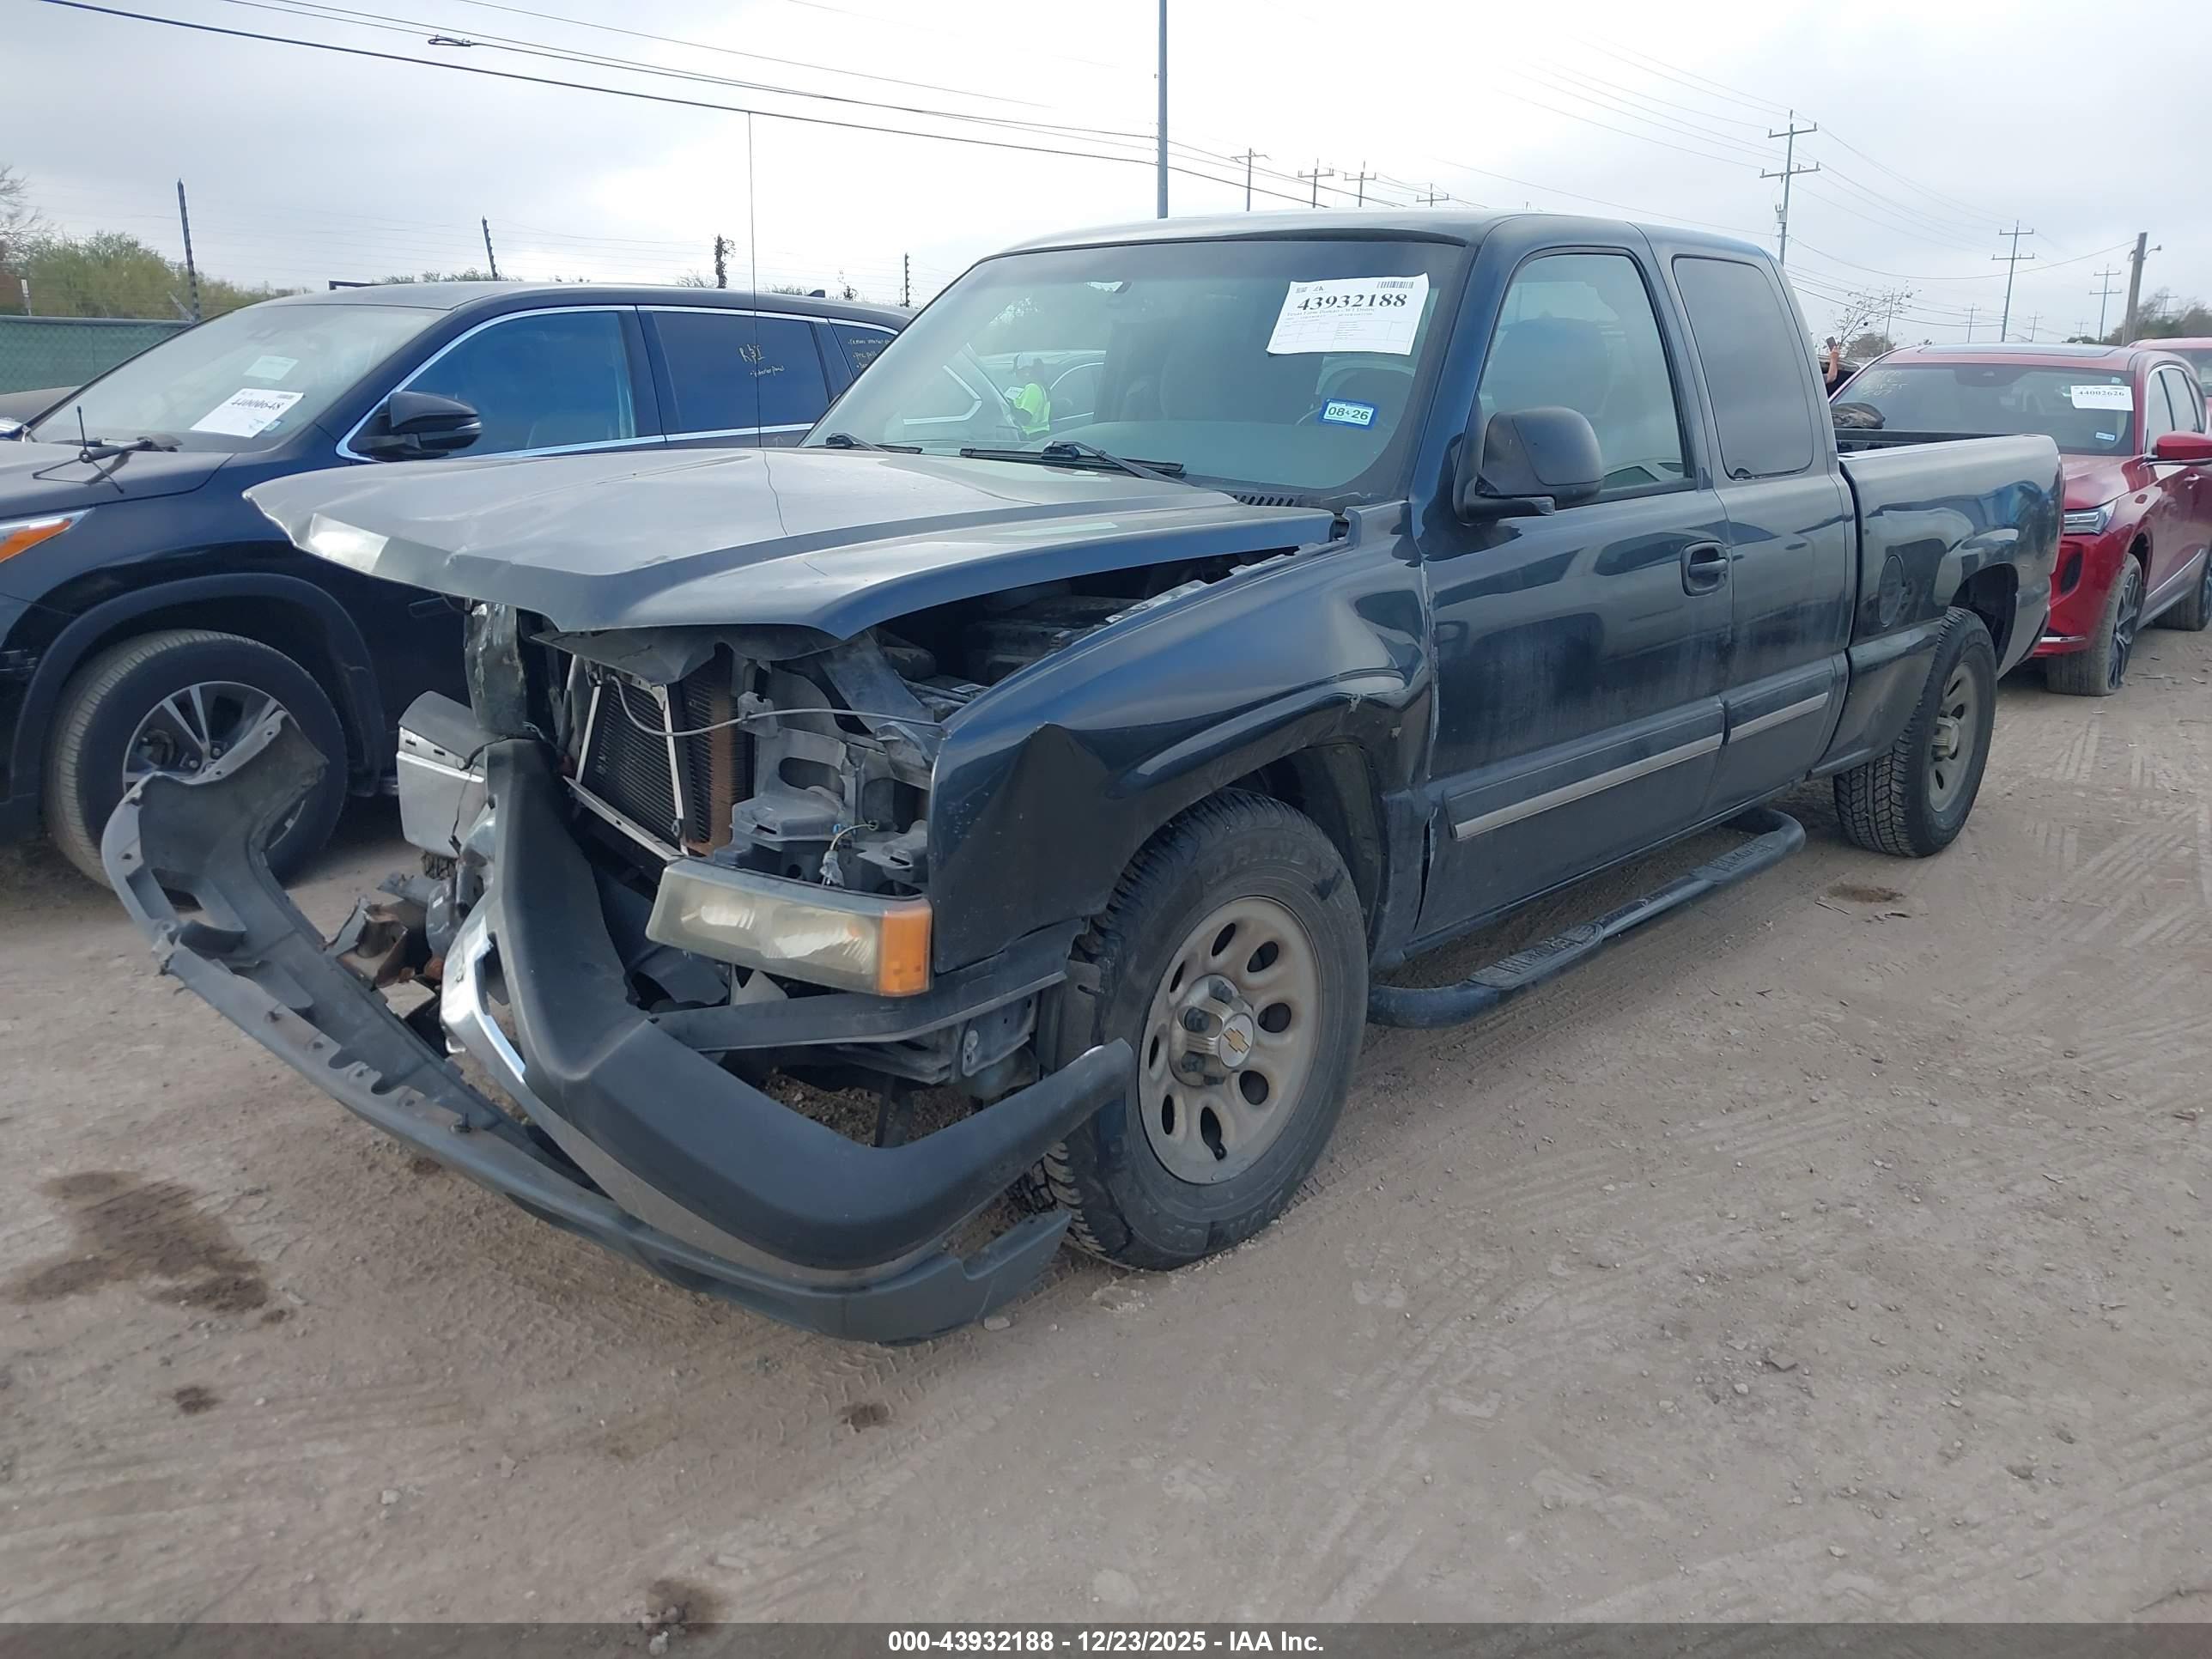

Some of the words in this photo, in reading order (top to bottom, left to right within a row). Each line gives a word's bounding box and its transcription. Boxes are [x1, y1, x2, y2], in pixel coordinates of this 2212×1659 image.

[1297, 293, 1407, 310] 43932188
[1328, 406, 1345, 416] 08
[1352, 409, 1370, 421] 26
